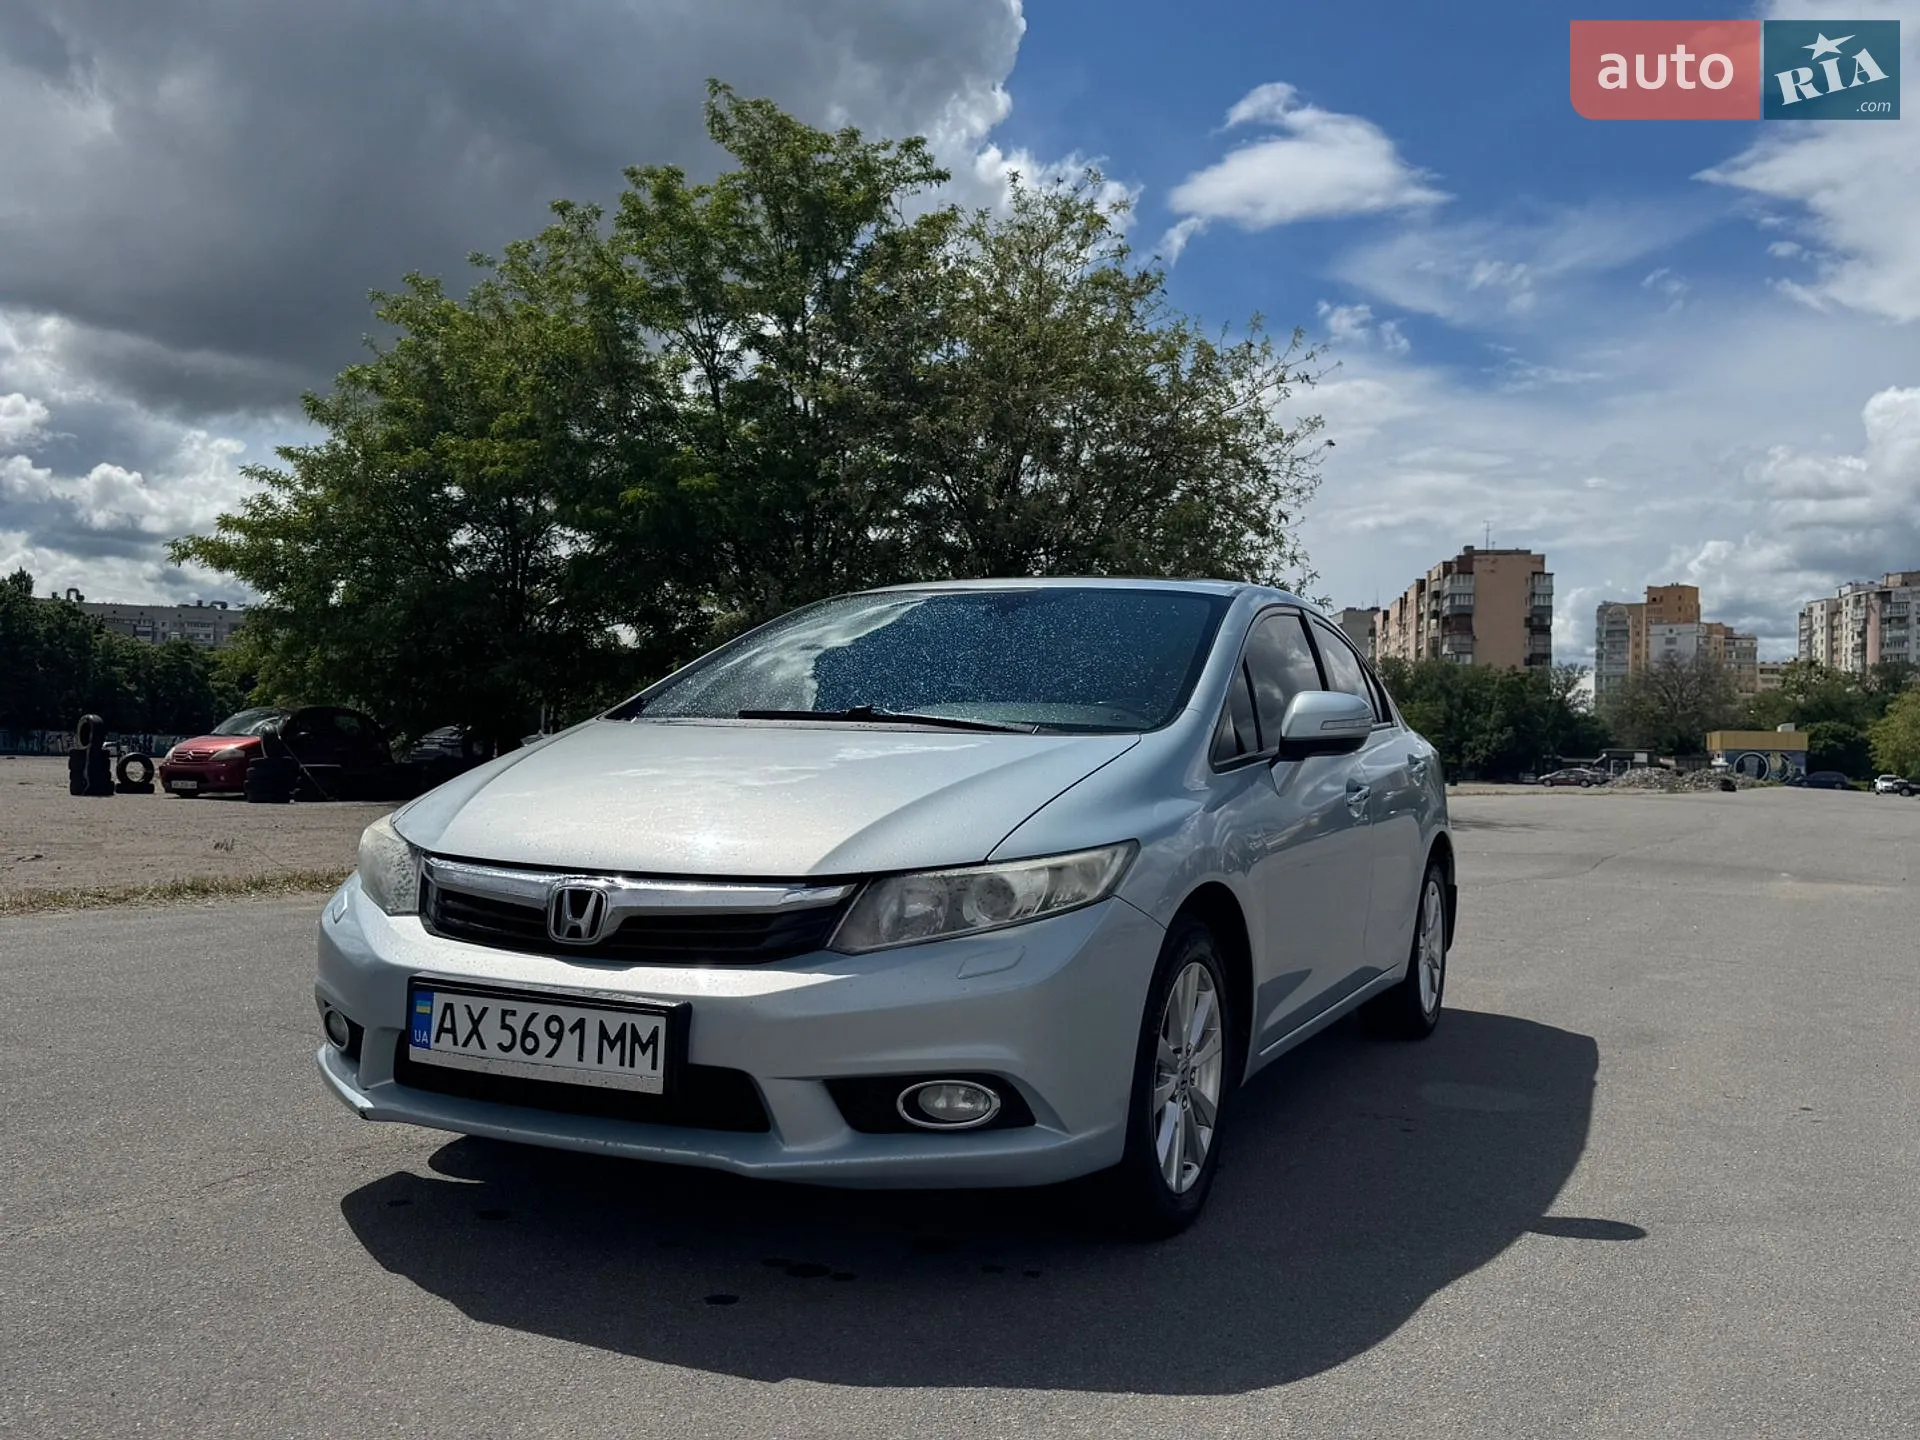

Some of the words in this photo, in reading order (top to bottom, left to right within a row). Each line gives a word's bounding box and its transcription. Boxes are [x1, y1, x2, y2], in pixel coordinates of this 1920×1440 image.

[414, 1029, 429, 1044] UA
[434, 1002, 489, 1050] AX
[496, 1008, 586, 1063] 5691
[597, 1019, 660, 1071] MM
